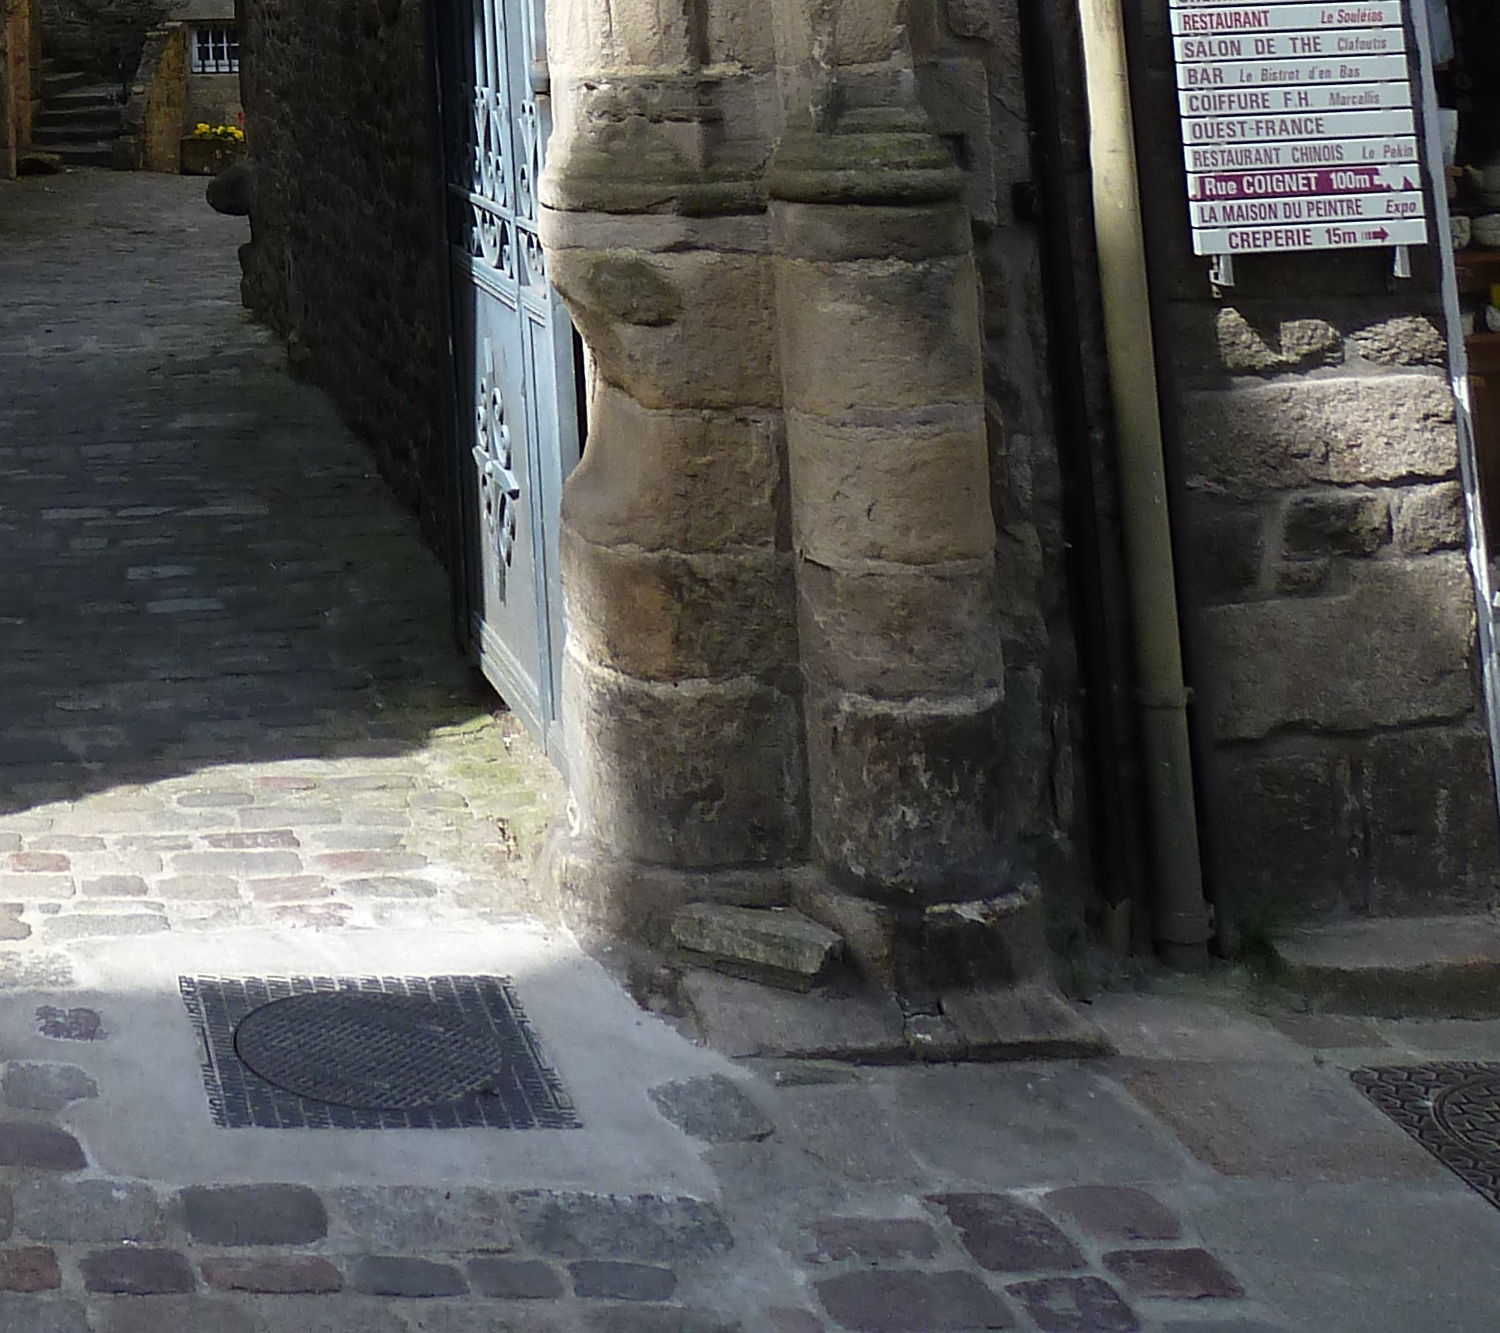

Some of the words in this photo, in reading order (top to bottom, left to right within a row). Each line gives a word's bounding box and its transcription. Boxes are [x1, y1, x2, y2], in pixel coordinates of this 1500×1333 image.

[1182, 10, 1270, 31] RESTAURANT
[1321, 10, 1334, 24] Le
[1184, 39, 1241, 59] SALON
[1255, 38, 1277, 55] DE
[1289, 36, 1322, 53] THE
[1337, 37, 1388, 52] Clafoutis
[1187, 67, 1224, 84] BAR
[1239, 68, 1253, 82] Le
[1261, 67, 1300, 81] Bistrot
[1340, 65, 1361, 79] Bas
[1189, 93, 1270, 112] COIFFURE
[1192, 118, 1326, 140] OUEST-FRANCE
[1193, 148, 1281, 168] RESTAURANT
[1291, 146, 1345, 163] CHINOIS
[1204, 178, 1237, 196] Rue
[1243, 173, 1319, 194] COIGNET
[1329, 172, 1370, 190] 100m
[1200, 206, 1218, 223] LA
[1222, 203, 1278, 222] MAISON
[1283, 201, 1302, 218] DU
[1307, 199, 1364, 217] PEINTRE
[1385, 199, 1417, 216] Expo
[1228, 229, 1313, 250] CREPERIE
[1325, 227, 1358, 244] 15m
